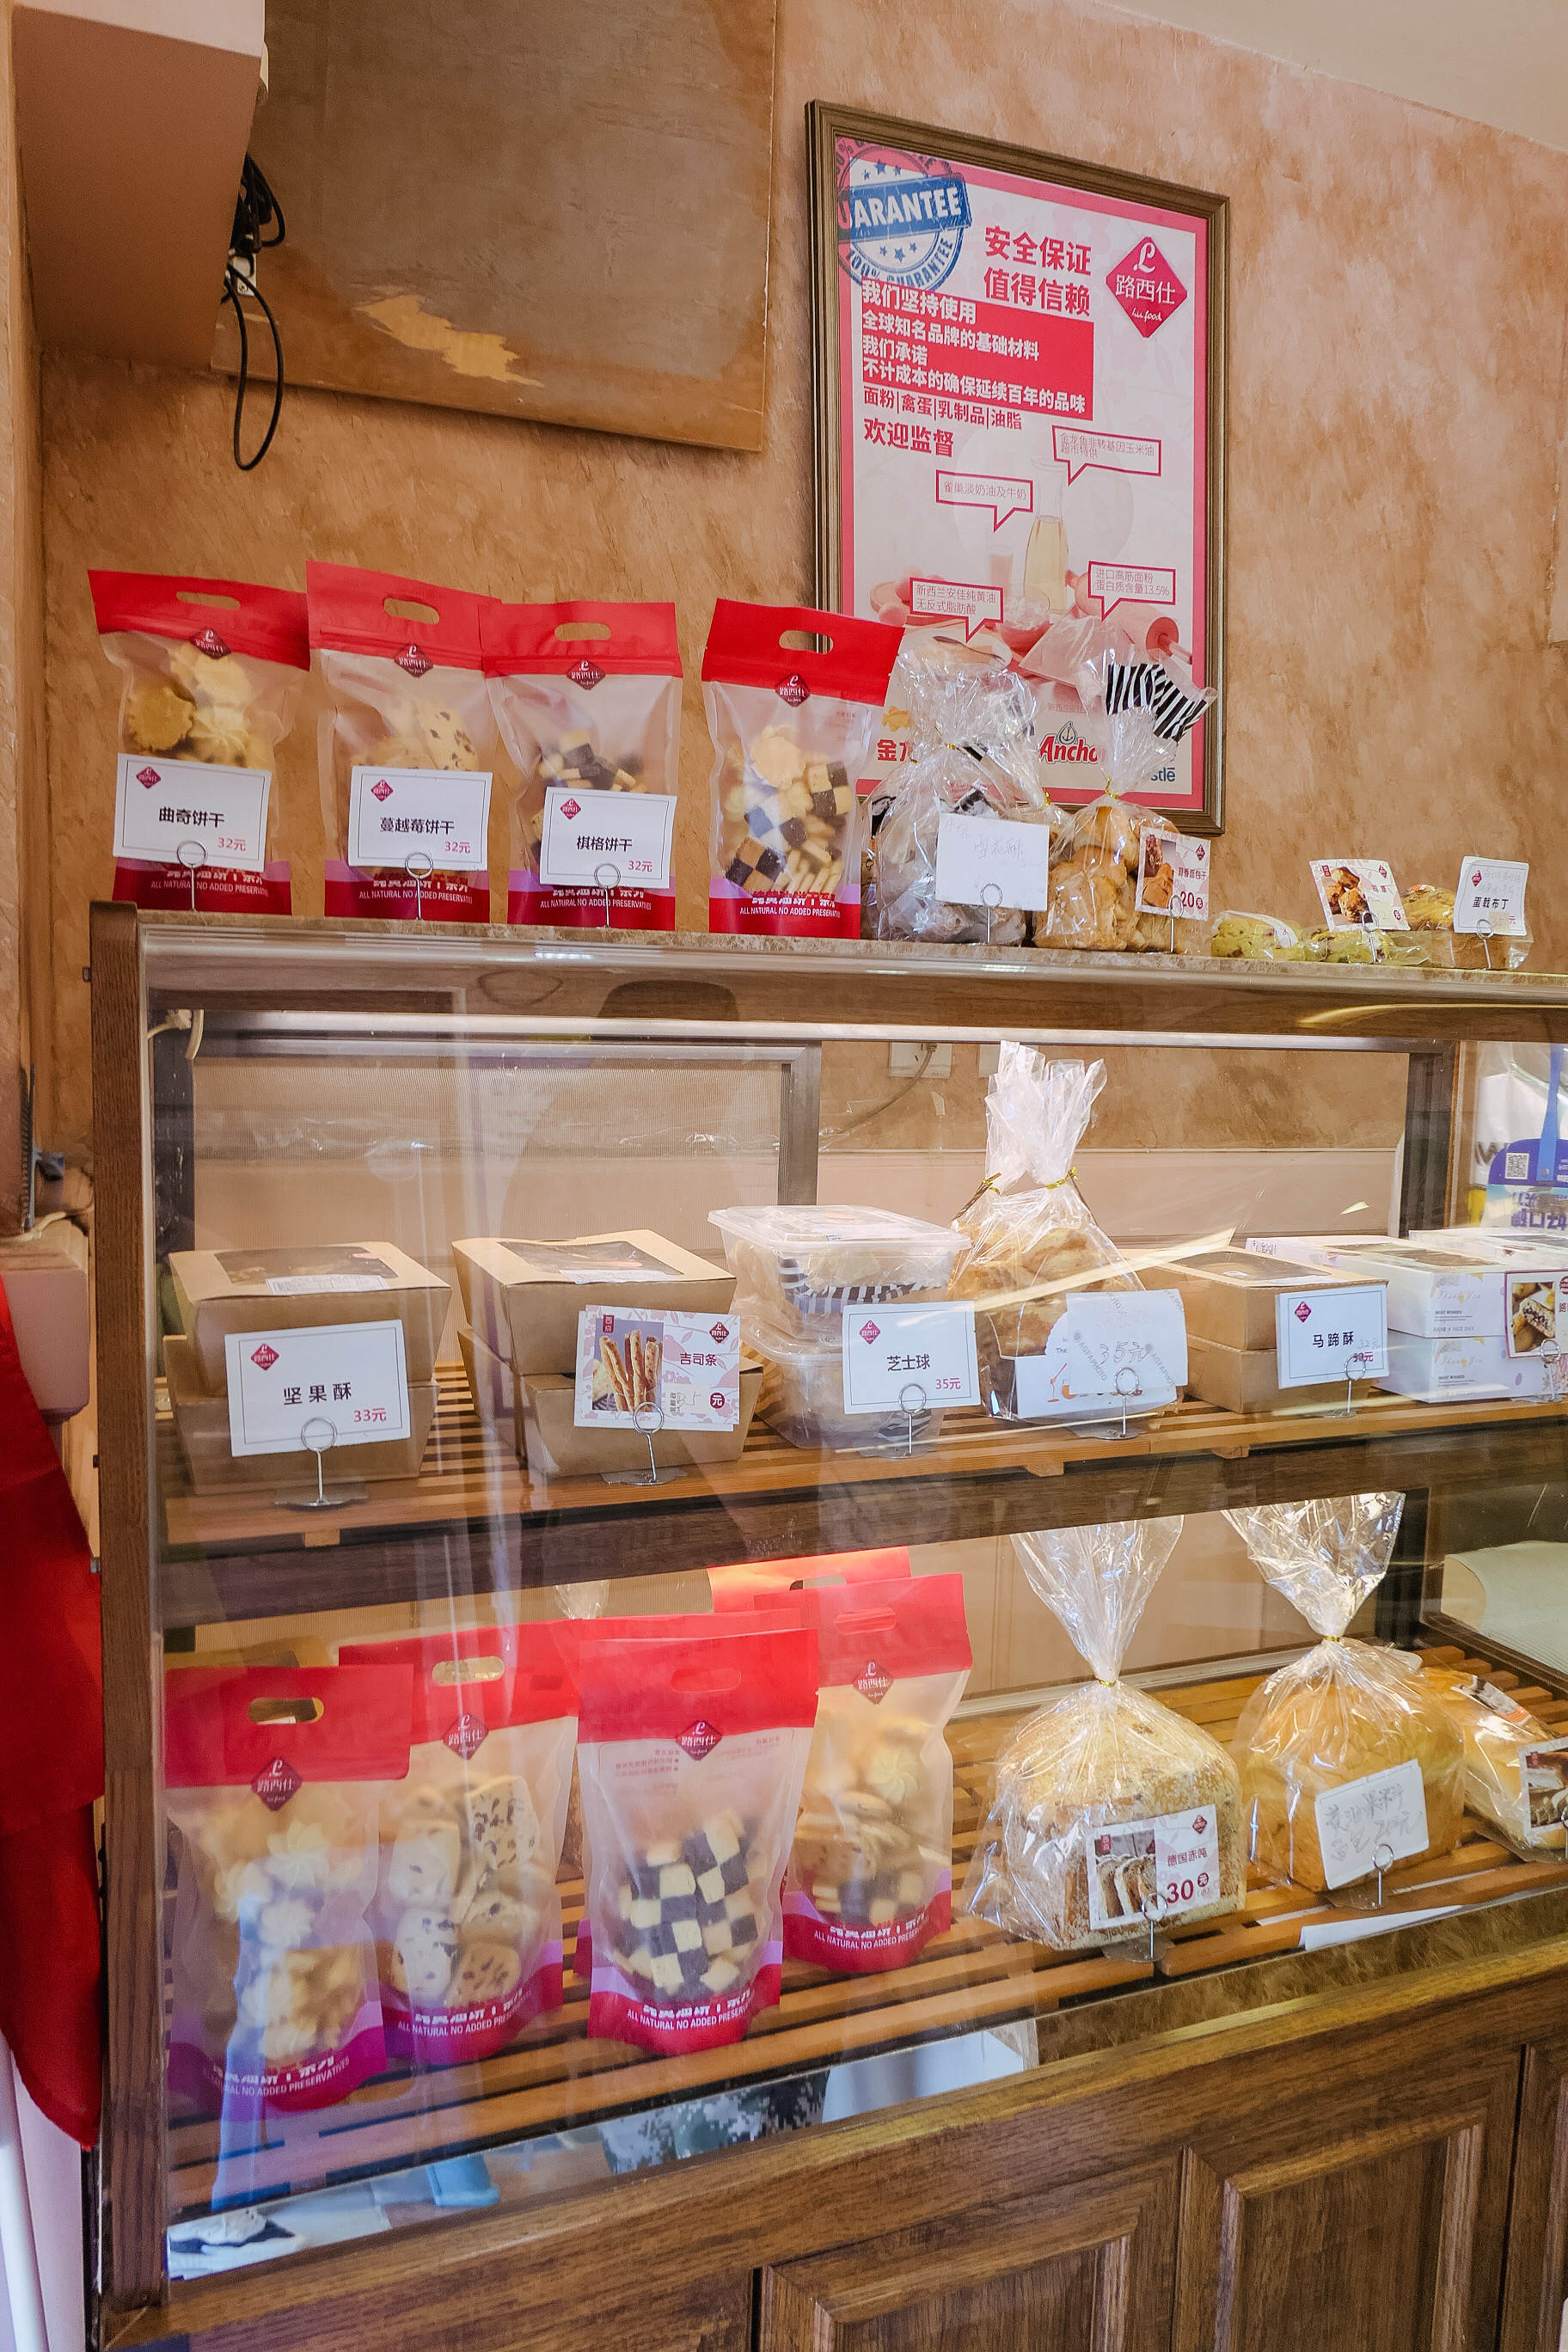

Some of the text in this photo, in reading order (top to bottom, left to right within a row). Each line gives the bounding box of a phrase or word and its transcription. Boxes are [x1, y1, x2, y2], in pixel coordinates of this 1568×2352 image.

[985, 226, 1092, 276] 安全保证
[983, 266, 1090, 316] 值得信赖
[1115, 274, 1176, 305] 路西仕
[861, 279, 977, 325] 我们坚持使用
[862, 309, 1039, 361] 全球知名品牌的基础材料
[862, 334, 928, 366] 我们承诺
[863, 357, 1086, 413] 不计成本的确保延续百年的品味
[863, 418, 954, 457] 欢迎监督
[944, 480, 1027, 501] 雀巢淡奶油及牛奶
[1096, 567, 1154, 585] 进口高筋面粉
[916, 585, 996, 604] 新西兰安佳纯黄油
[916, 597, 977, 615] 无反式脂肪酸
[158, 806, 225, 828] 曲奇饼干
[379, 817, 456, 835] 蔓越莓饼干
[217, 836, 247, 852] 32元
[444, 840, 471, 854] 32元
[576, 835, 634, 853] 棋格饼干
[628, 861, 653, 873] 32元
[163, 879, 192, 890] NATURA
[210, 883, 234, 892] ADDED
[371, 891, 401, 899] NATURAL
[402, 891, 413, 899] NO
[540, 900, 550, 909] ALL
[550, 899, 577, 908] NATURAL
[577, 898, 587, 907] NO
[1179, 891, 1194, 908] 20
[790, 908, 811, 916] ADDED
[1313, 1331, 1354, 1348] 马蹄酥
[679, 1352, 717, 1366] 吉司条
[886, 1354, 930, 1373] 芝士球
[935, 1377, 961, 1390] 35元
[283, 1382, 352, 1406] 坚果酥
[712, 1395, 722, 1406] 元
[353, 1407, 387, 1422] 33元
[1167, 1878, 1194, 1903] 30
[814, 1930, 825, 1941] ALL
[826, 1935, 859, 1950] NATURAL
[861, 1940, 872, 1950] NO
[873, 1937, 897, 1948] ADDED
[628, 2008, 639, 2022] ALL
[640, 2014, 674, 2030] NATURAL
[676, 2020, 689, 2030] NO
[690, 2016, 717, 2028] ADDED
[412, 2022, 448, 2037] NATURAL
[450, 2024, 463, 2035] NO
[465, 2020, 492, 2034] ADDED
